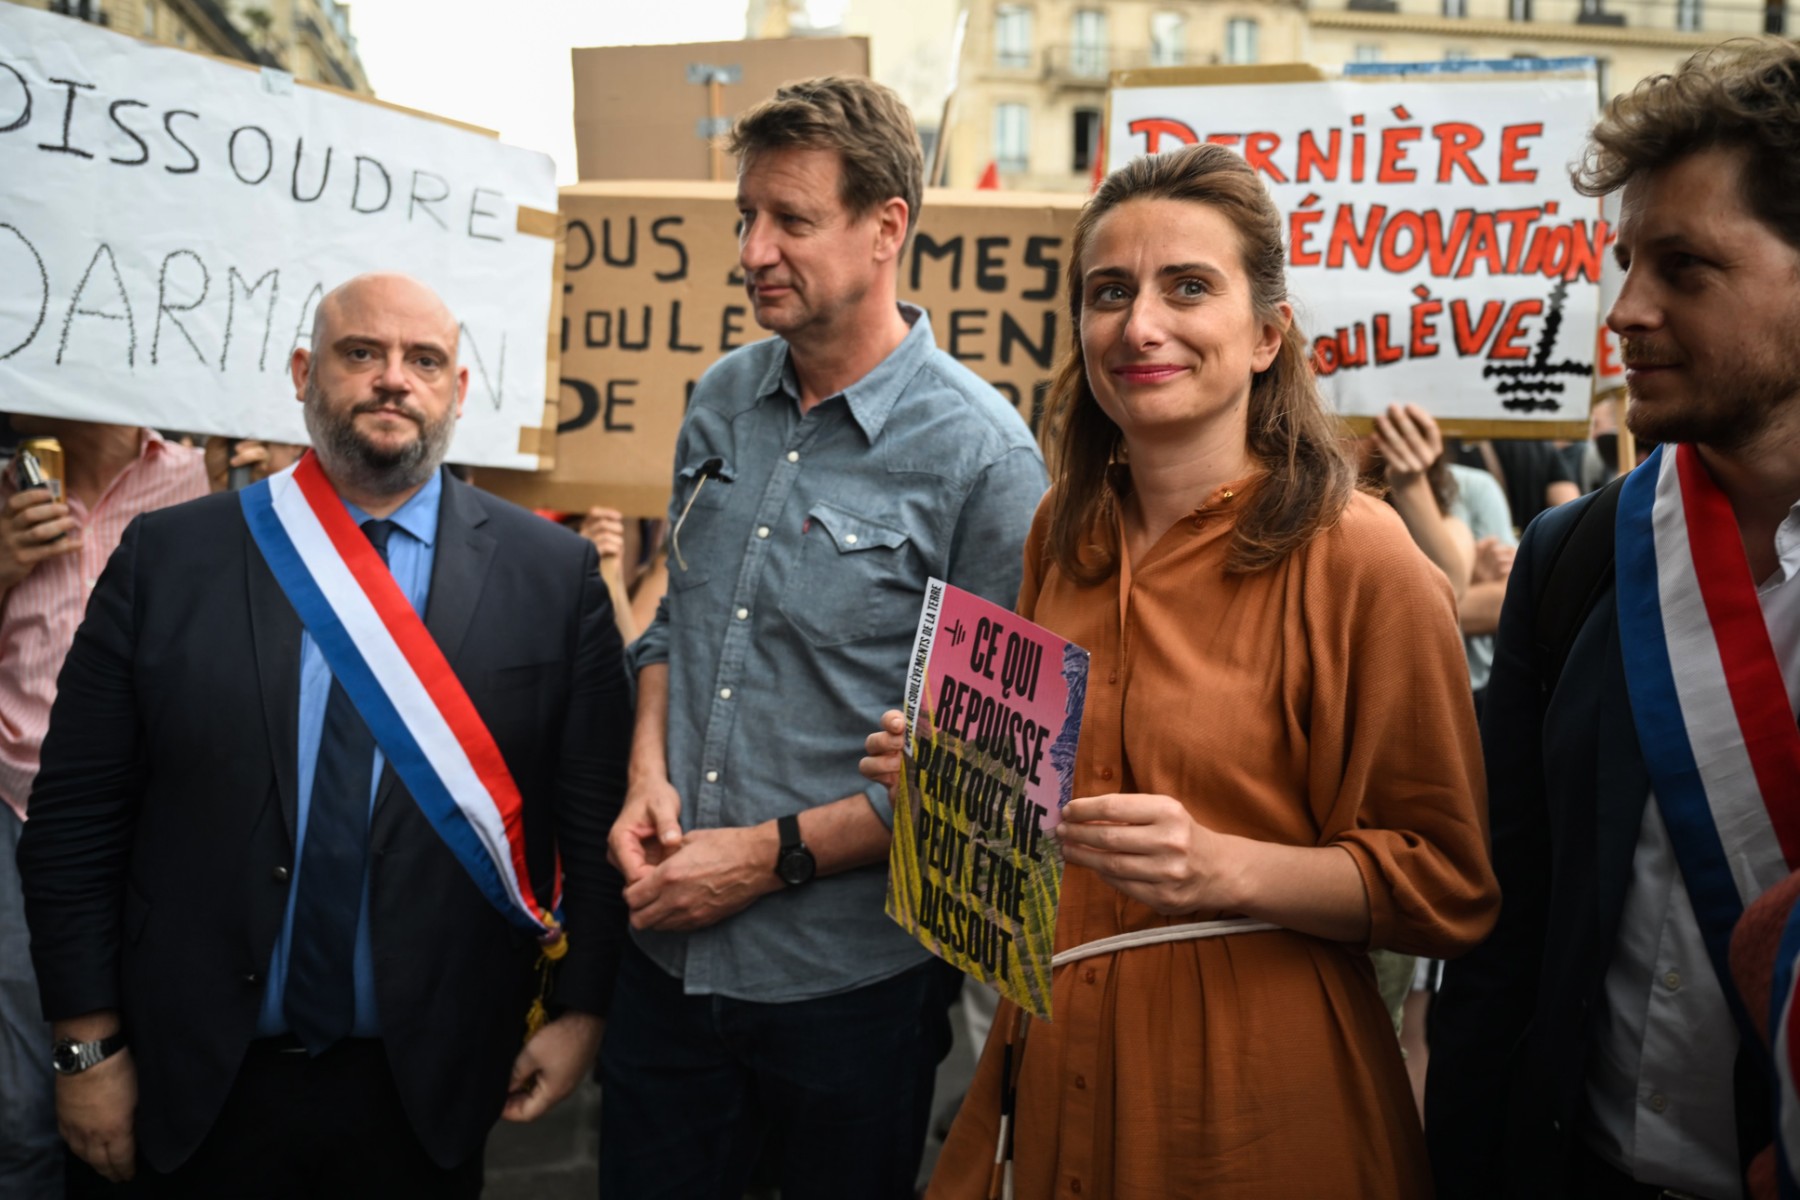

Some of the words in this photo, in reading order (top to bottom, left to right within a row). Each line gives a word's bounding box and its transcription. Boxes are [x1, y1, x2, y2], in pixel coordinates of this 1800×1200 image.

[0, 62, 505, 243] DISSOUDRE
[564, 215, 689, 283] OUS
[0, 223, 506, 411] DARMAN
[1308, 283, 1544, 376] OULÈVE
[922, 624, 933, 637] DE
[925, 612, 936, 624] LA
[927, 584, 942, 611] TERRE
[908, 636, 930, 704] SOULÈVEMENTS
[970, 616, 1004, 680] CE
[1001, 631, 1043, 702] QUI
[906, 705, 916, 721] AUX
[934, 674, 1050, 786] REPOUSSE
[915, 736, 1012, 840] PARTOUT
[1011, 793, 1047, 863] NE
[917, 807, 970, 885] PEUT
[971, 830, 1028, 925] ÊTRE
[919, 876, 1012, 982] DISSOUT
